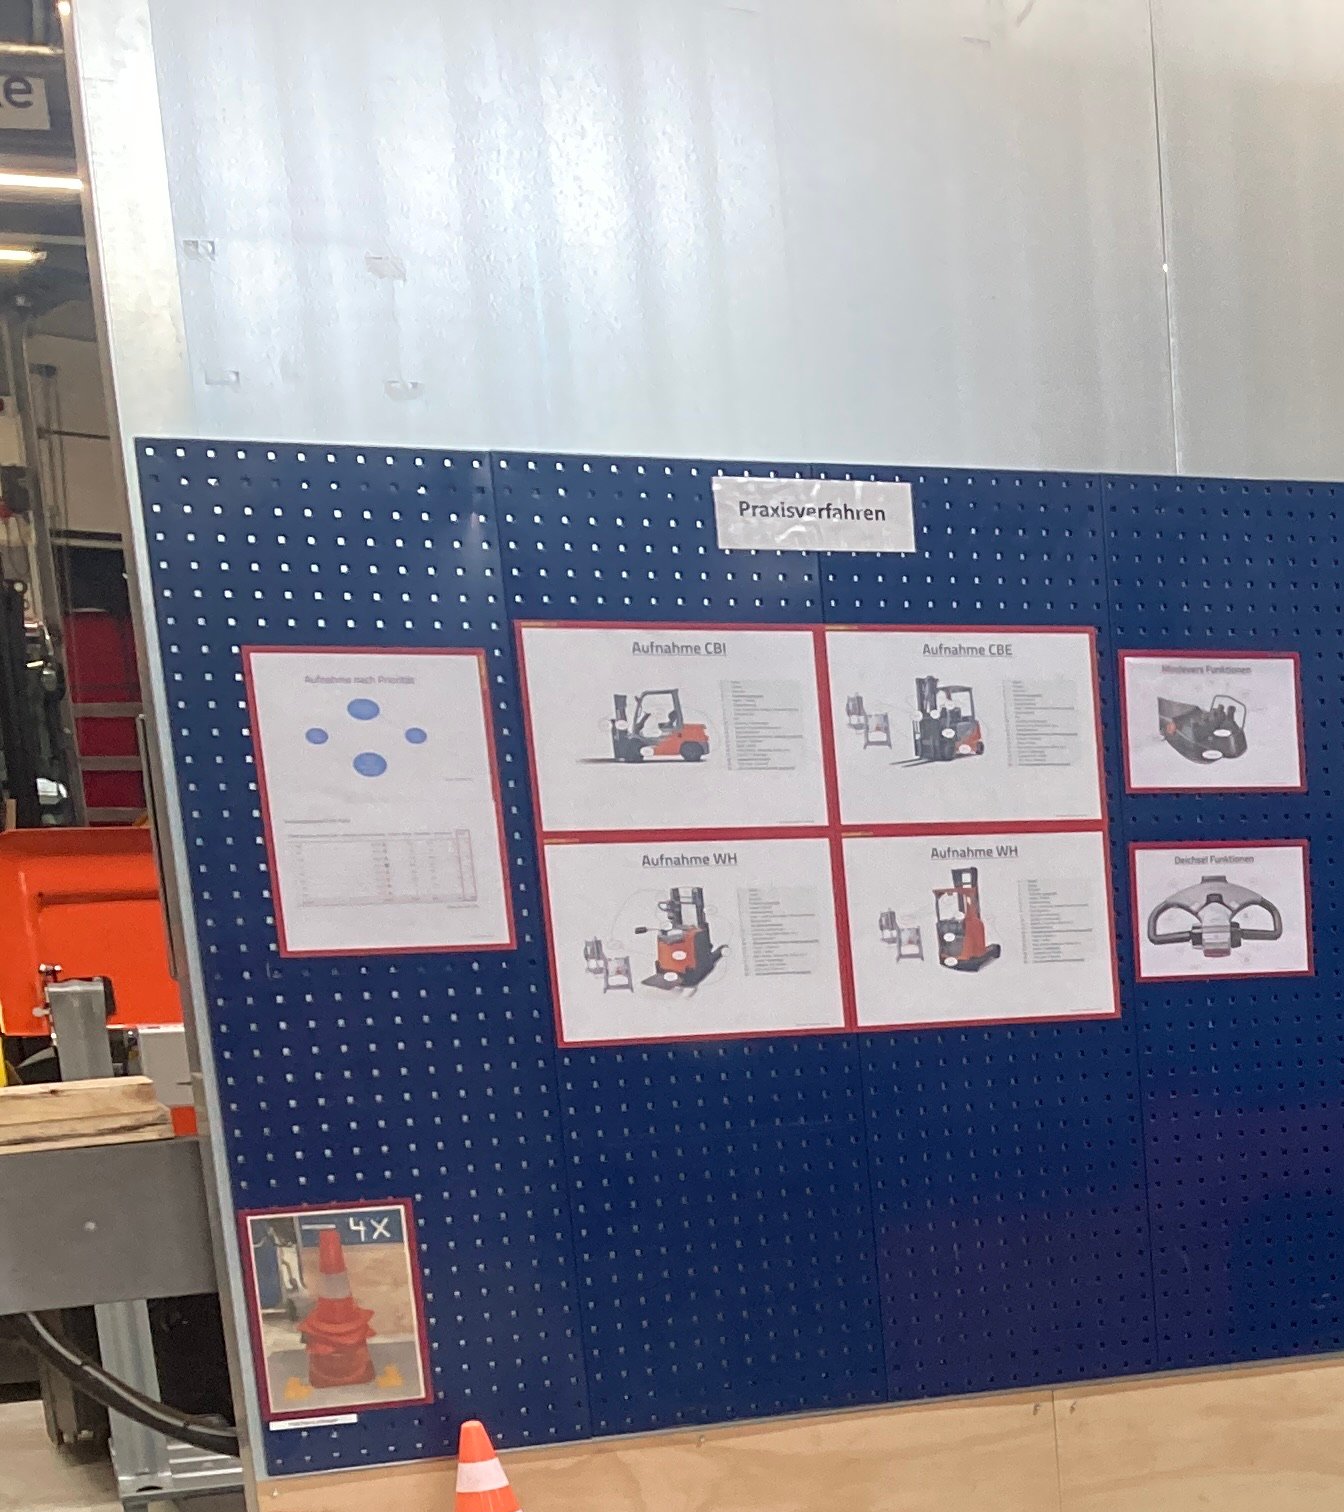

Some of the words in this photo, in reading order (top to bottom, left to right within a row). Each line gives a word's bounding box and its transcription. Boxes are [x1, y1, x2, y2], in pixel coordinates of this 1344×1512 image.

[738, 500, 887, 522] Praxisverfahren
[632, 641, 701, 655] Aufnahme
[922, 643, 986, 656] Aufnahme
[988, 643, 1013, 656] CBE
[931, 846, 994, 859] Aufnahme
[996, 845, 1019, 857] WH
[641, 853, 711, 867] Aufnahme
[712, 852, 738, 865] WH
